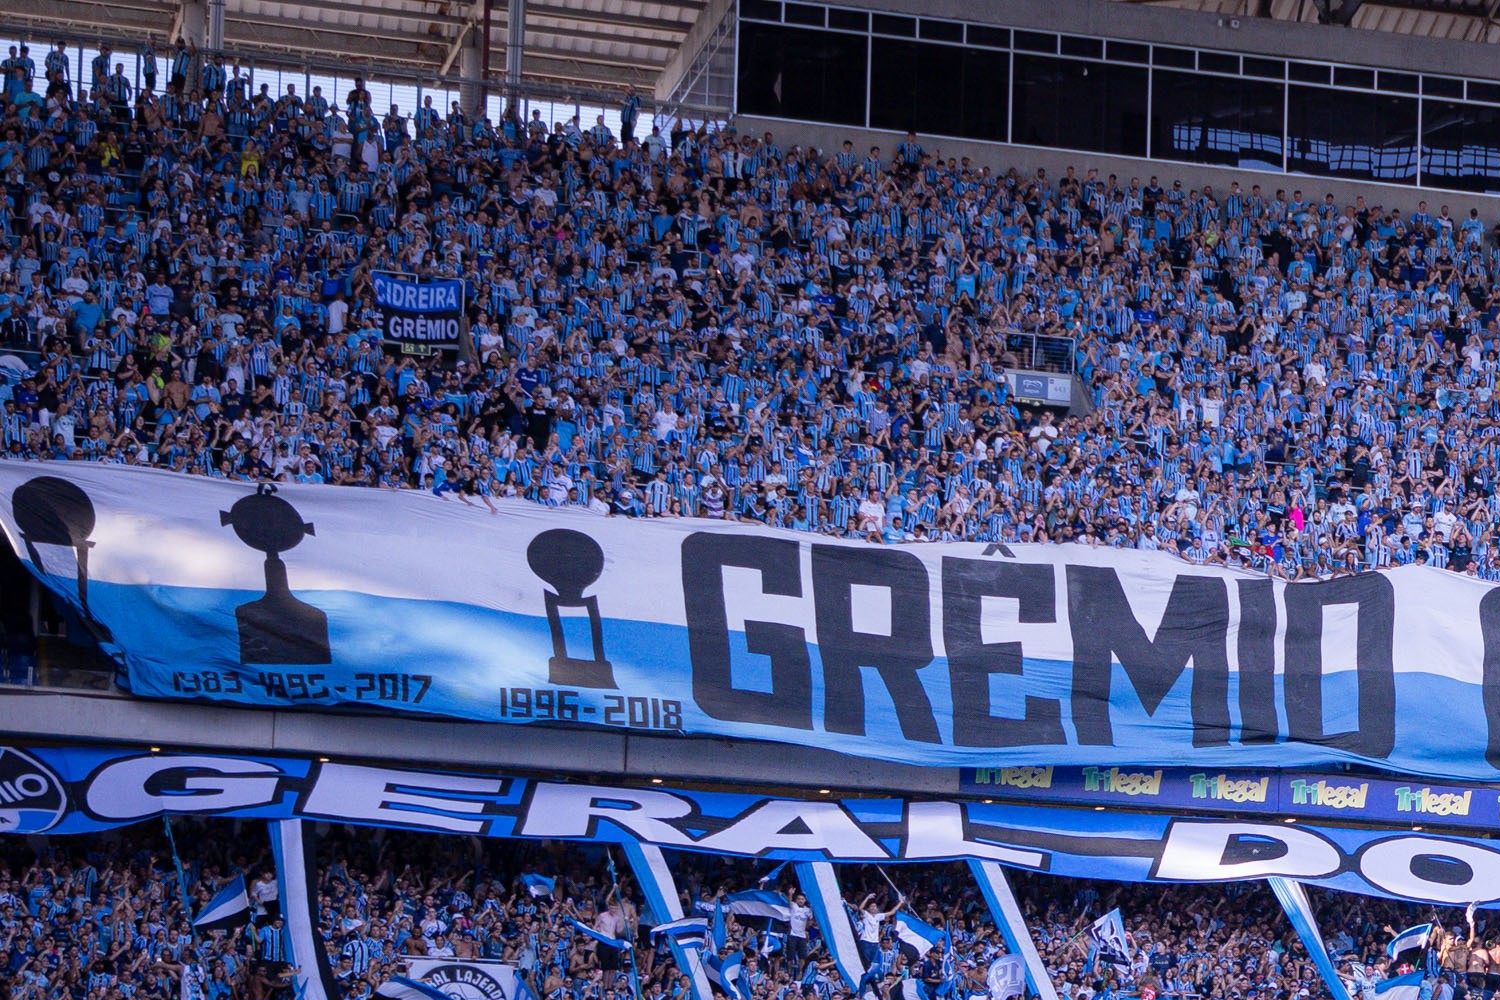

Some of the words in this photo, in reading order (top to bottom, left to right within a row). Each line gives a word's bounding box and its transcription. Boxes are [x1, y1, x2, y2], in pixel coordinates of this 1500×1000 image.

[374, 278, 457, 309] CIDREIRA
[389, 314, 459, 339] GRÊMIO
[681, 532, 1395, 758] GRÊMIO
[500, 687, 683, 729] 1996-2018
[87, 755, 1044, 870] GERAL
[1082, 767, 1163, 796] Trilegal
[1189, 773, 1269, 803] Trilegal
[1290, 779, 1369, 809] Trilegal
[1396, 786, 1472, 816] Trilegal
